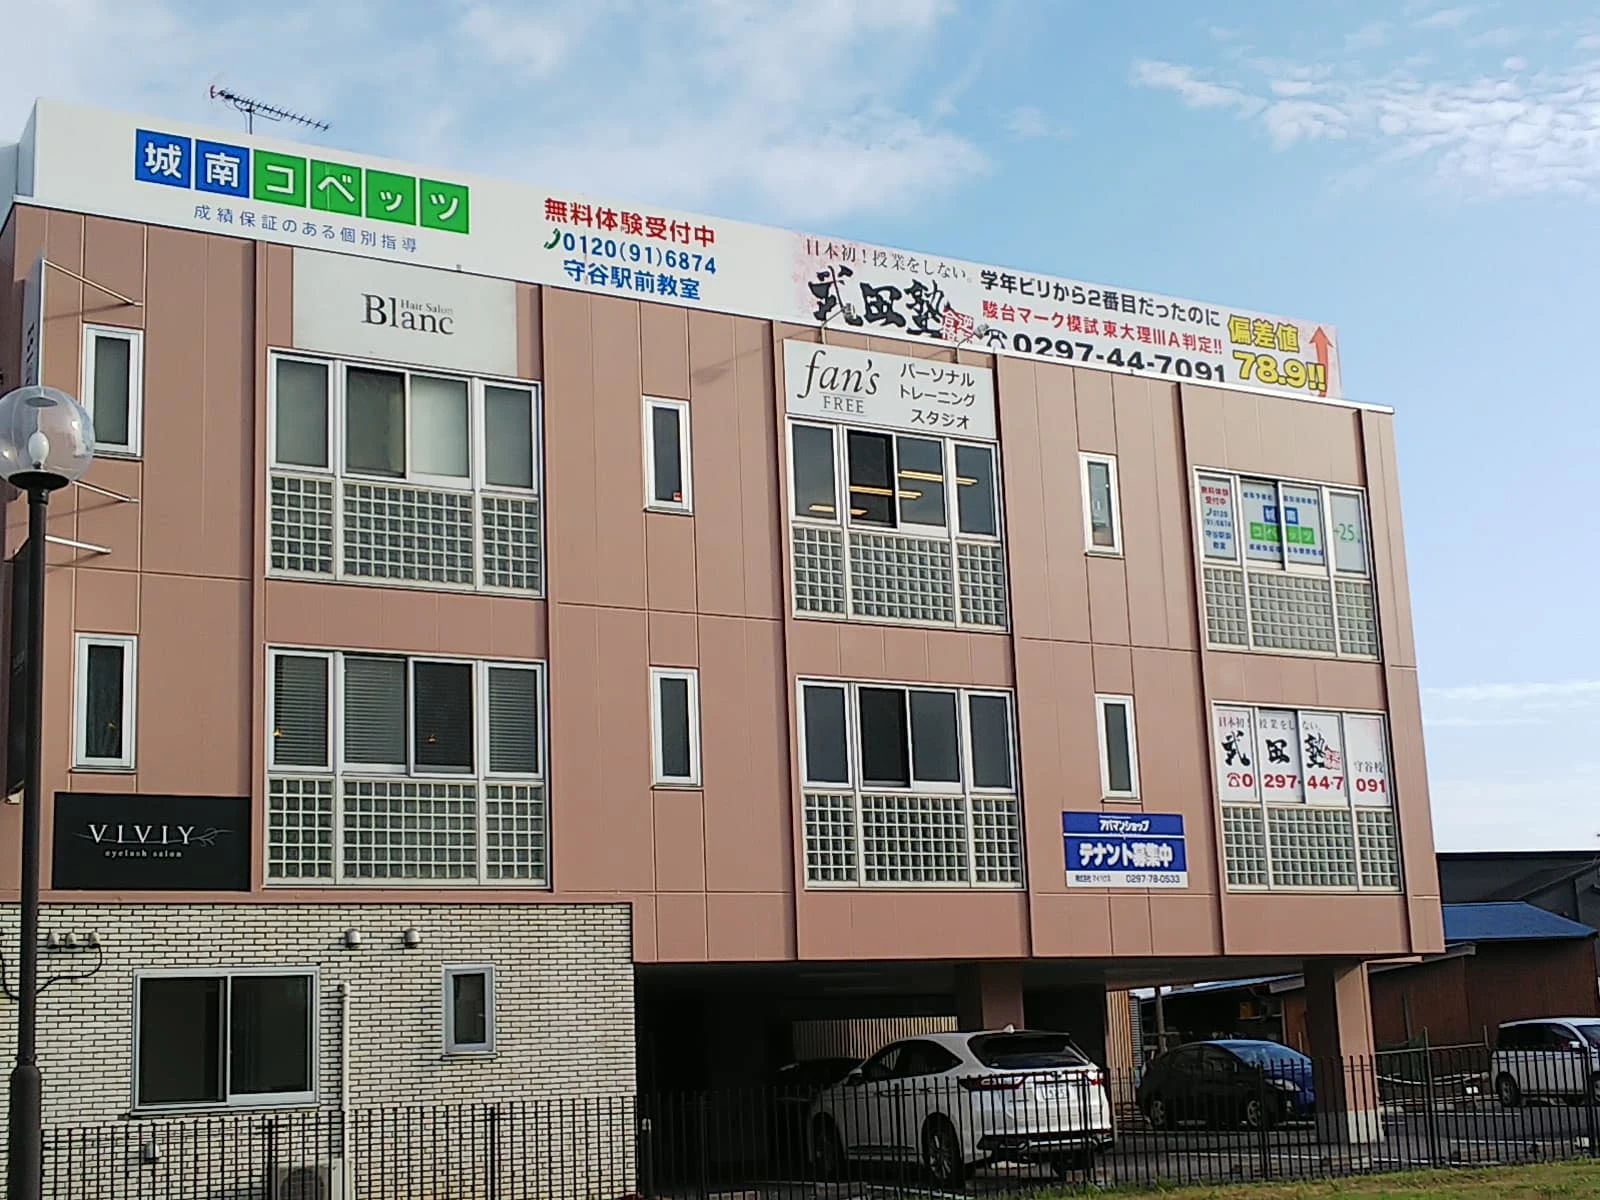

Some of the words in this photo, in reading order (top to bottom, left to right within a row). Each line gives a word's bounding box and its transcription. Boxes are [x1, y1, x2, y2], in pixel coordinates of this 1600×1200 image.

[143, 141, 460, 221] 城南コベッツ
[193, 203, 418, 254] 成績保証のある個別指導
[544, 197, 716, 248] 無料体験受付中
[563, 232, 717, 274] 0120(91)6874
[563, 258, 701, 300] 守谷駅前教室
[979, 268, 1221, 327] 学年ビリから2番目だったのに
[360, 292, 455, 336] Blanc
[401, 299, 423, 311] Hair
[808, 264, 947, 338] 武田塾
[1226, 313, 1300, 353] 偏差値
[796, 349, 881, 400] fan's
[900, 362, 976, 388] パーソナル
[1013, 332, 1225, 383] 0297-44-7091
[823, 395, 865, 414] FREE
[899, 383, 976, 408] トレーニング
[910, 409, 970, 430] スタジオ
[88, 824, 195, 845] VIVIY
[152, 850, 183, 858] salon
[1079, 842, 1174, 868] テナント募集中
